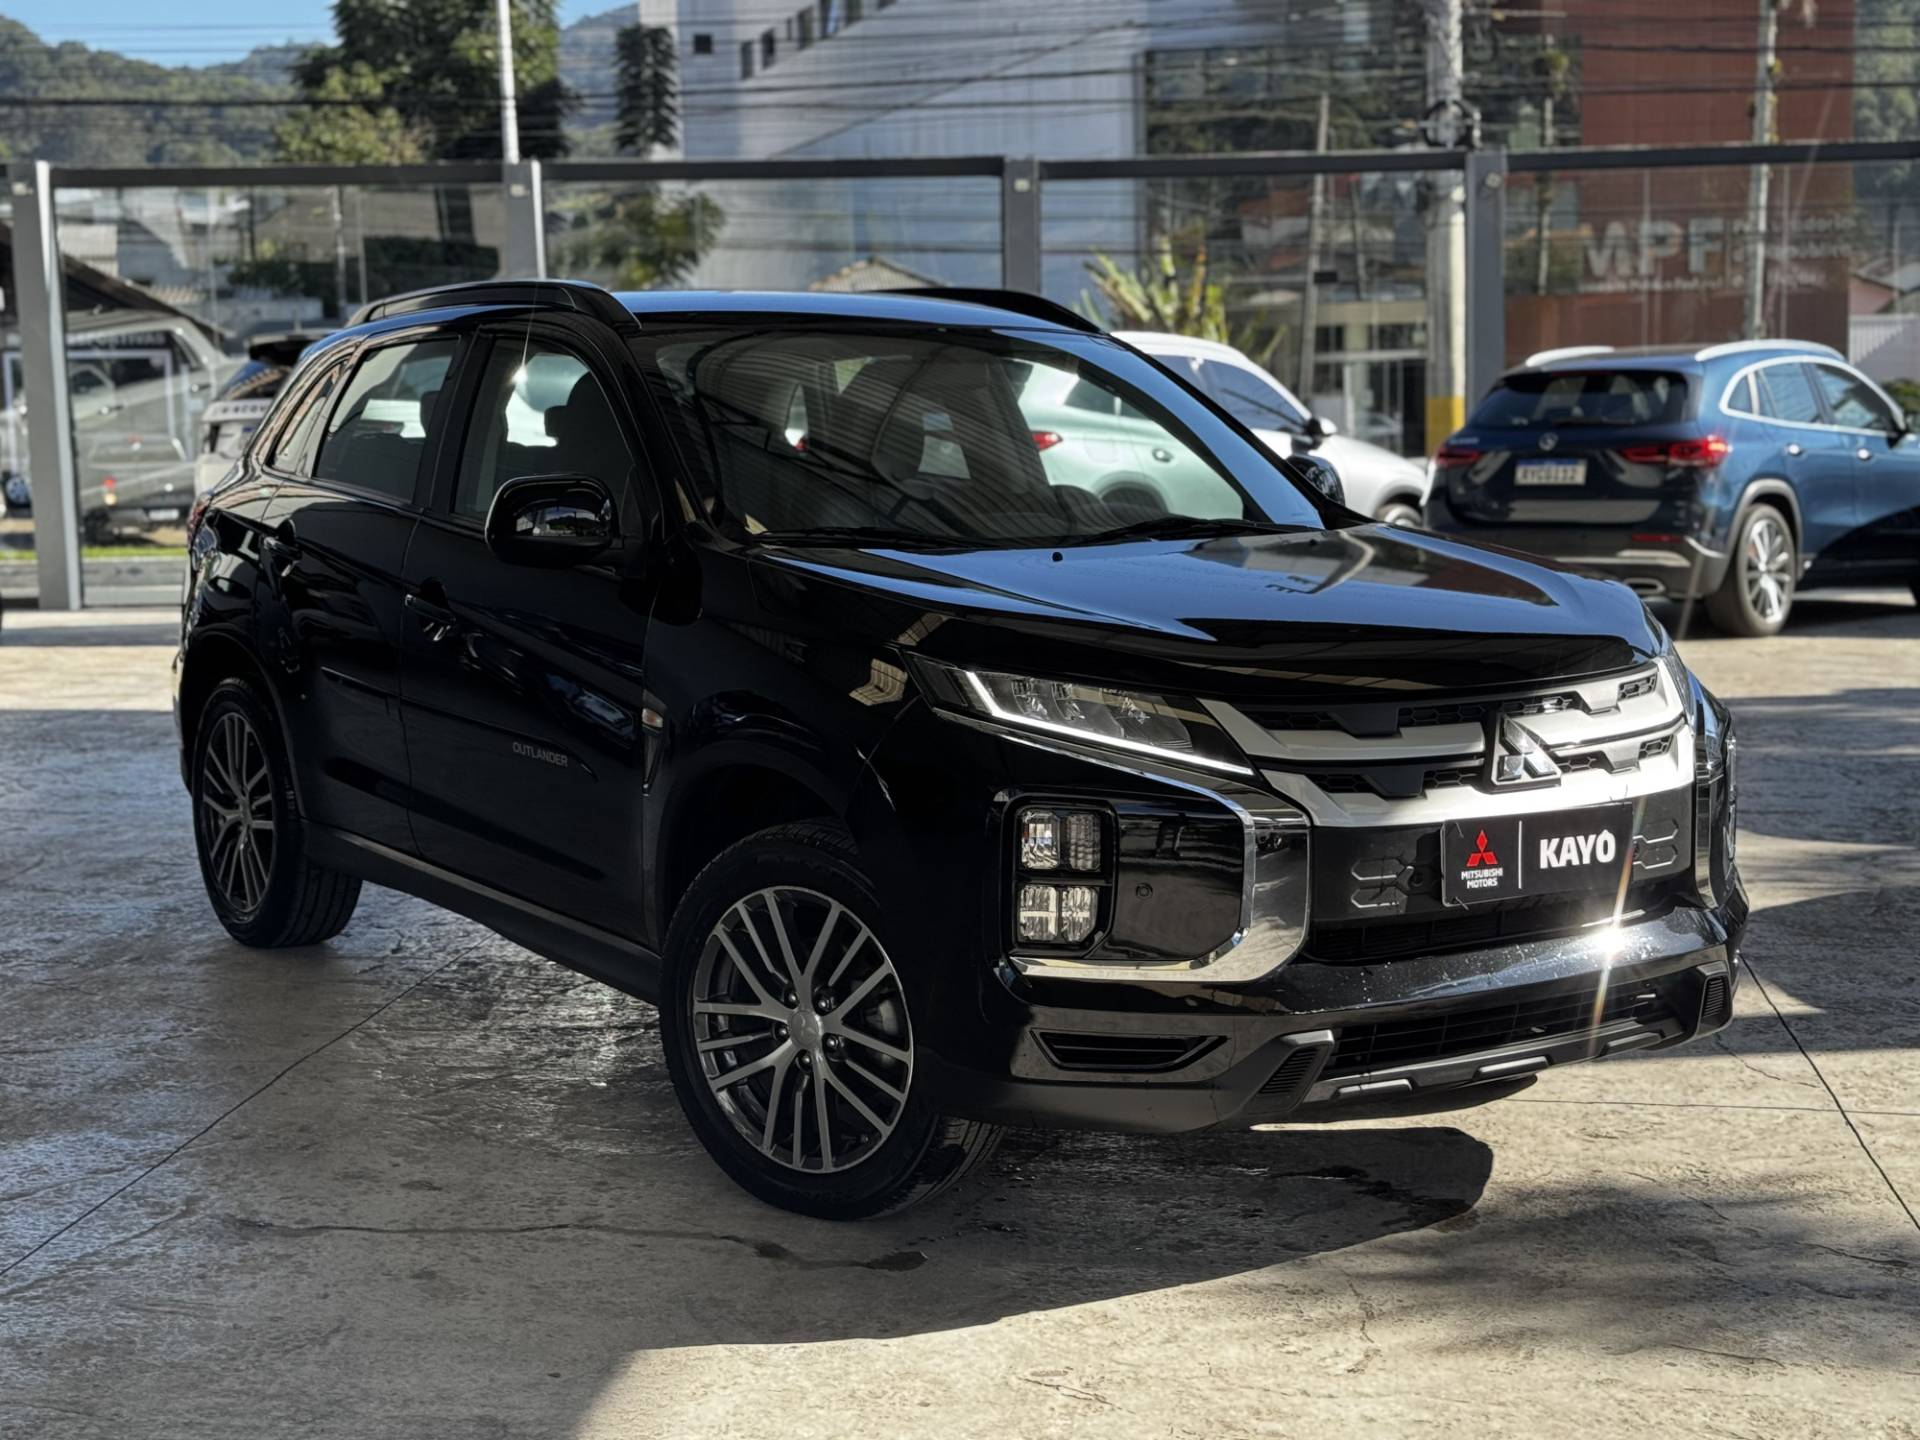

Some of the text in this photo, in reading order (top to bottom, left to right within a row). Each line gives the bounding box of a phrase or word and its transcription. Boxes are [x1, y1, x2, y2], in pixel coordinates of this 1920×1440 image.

[512, 741, 568, 768] OUTLANDER
[1461, 867, 1503, 881] MITSUBISHI
[1467, 877, 1498, 889] MOTORS
